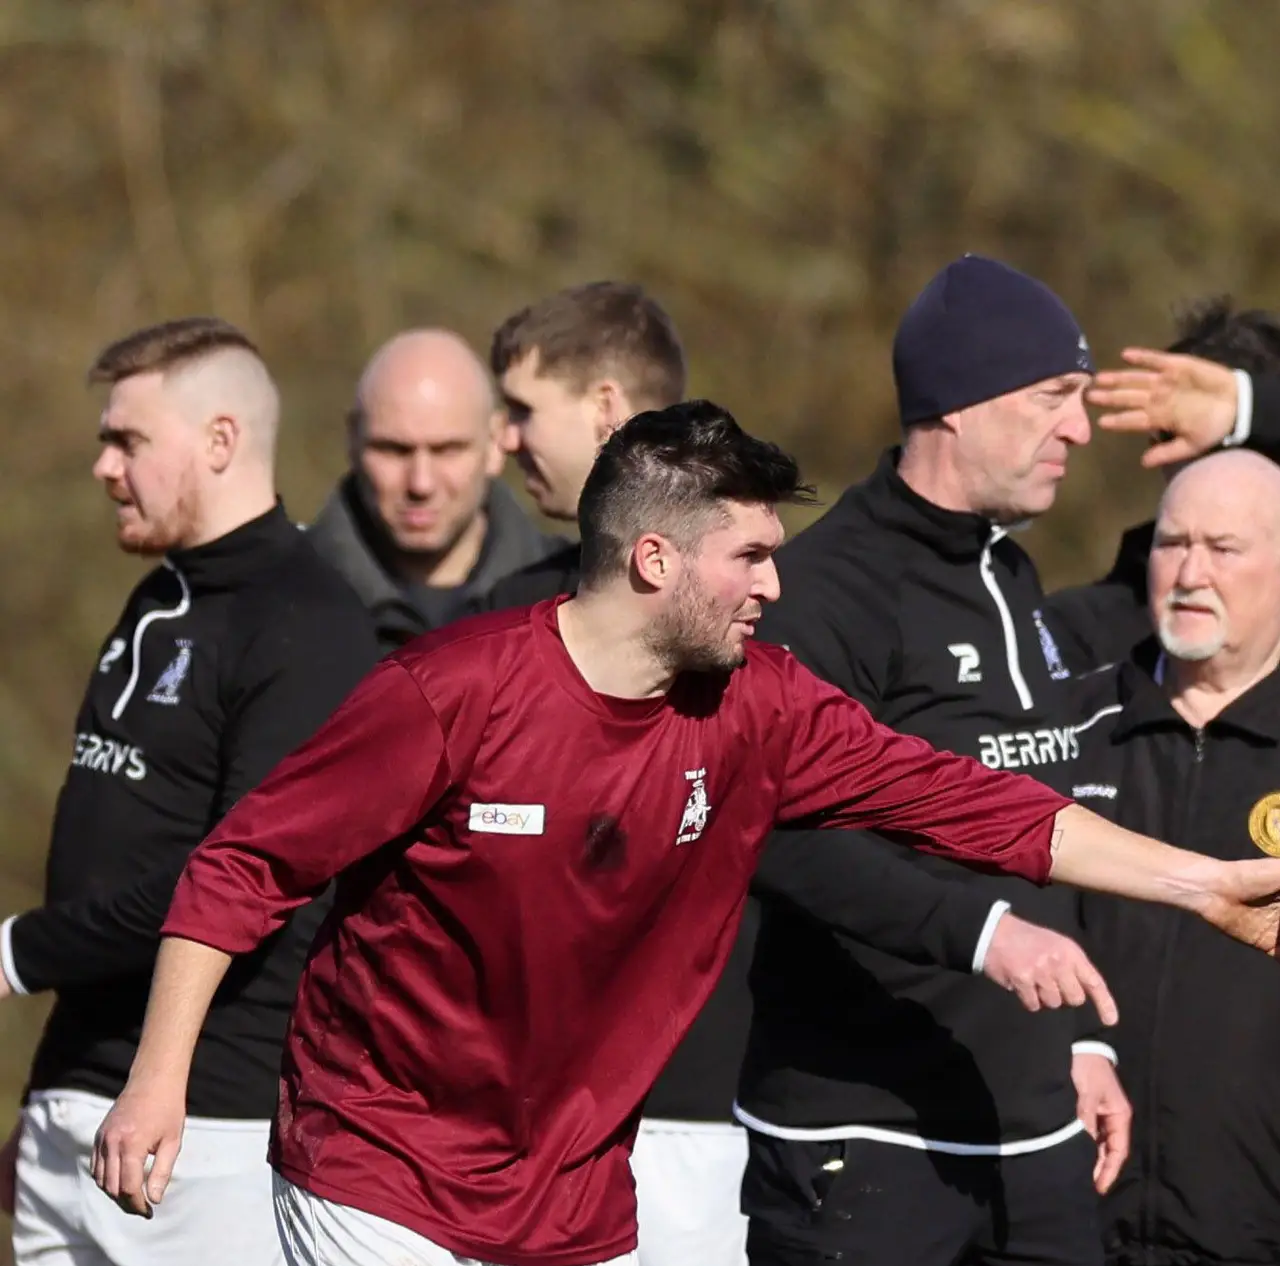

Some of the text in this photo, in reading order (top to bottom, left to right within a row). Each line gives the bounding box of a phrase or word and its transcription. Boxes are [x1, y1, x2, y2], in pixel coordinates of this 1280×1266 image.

[73, 732, 147, 780] ERRYS
[979, 725, 1080, 770] BERRYS
[482, 807, 530, 830] ebay
